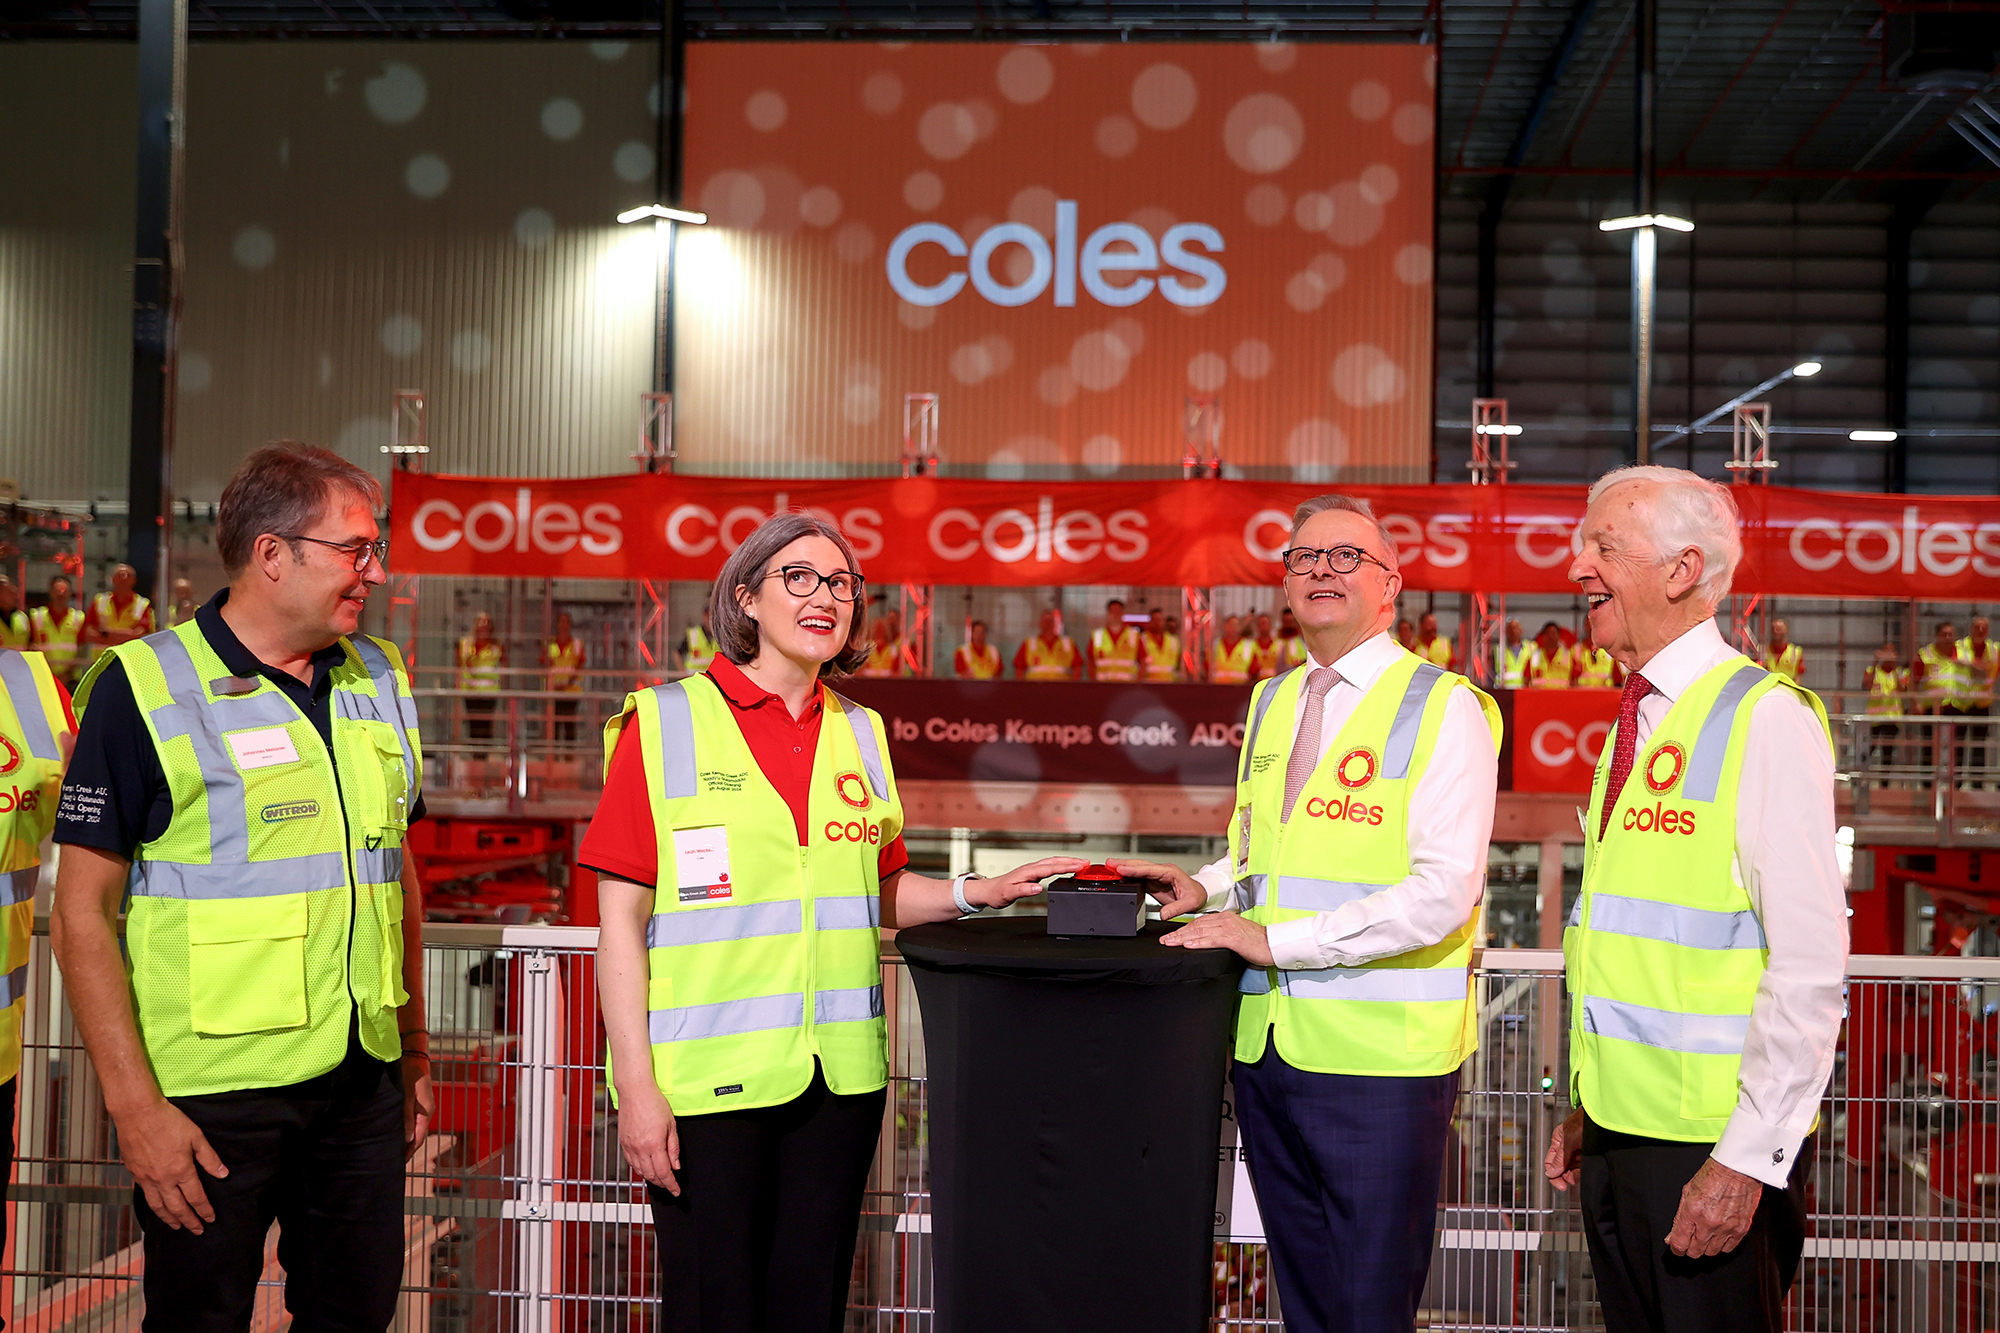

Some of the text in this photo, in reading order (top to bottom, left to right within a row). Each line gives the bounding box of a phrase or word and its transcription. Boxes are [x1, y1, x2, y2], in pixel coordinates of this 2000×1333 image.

[886, 200, 1228, 308] coles
[411, 487, 624, 556] coles
[666, 492, 884, 560] cos
[927, 496, 1150, 563] coles
[892, 717, 1247, 749] to Coles Kemps Creek ADC
[77, 803, 102, 816] Opening
[265, 804, 317, 818] WITRON
[1306, 795, 1384, 826] coles
[1623, 802, 1696, 835] coles
[825, 817, 879, 845] cole
[710, 887, 731, 896] coles
